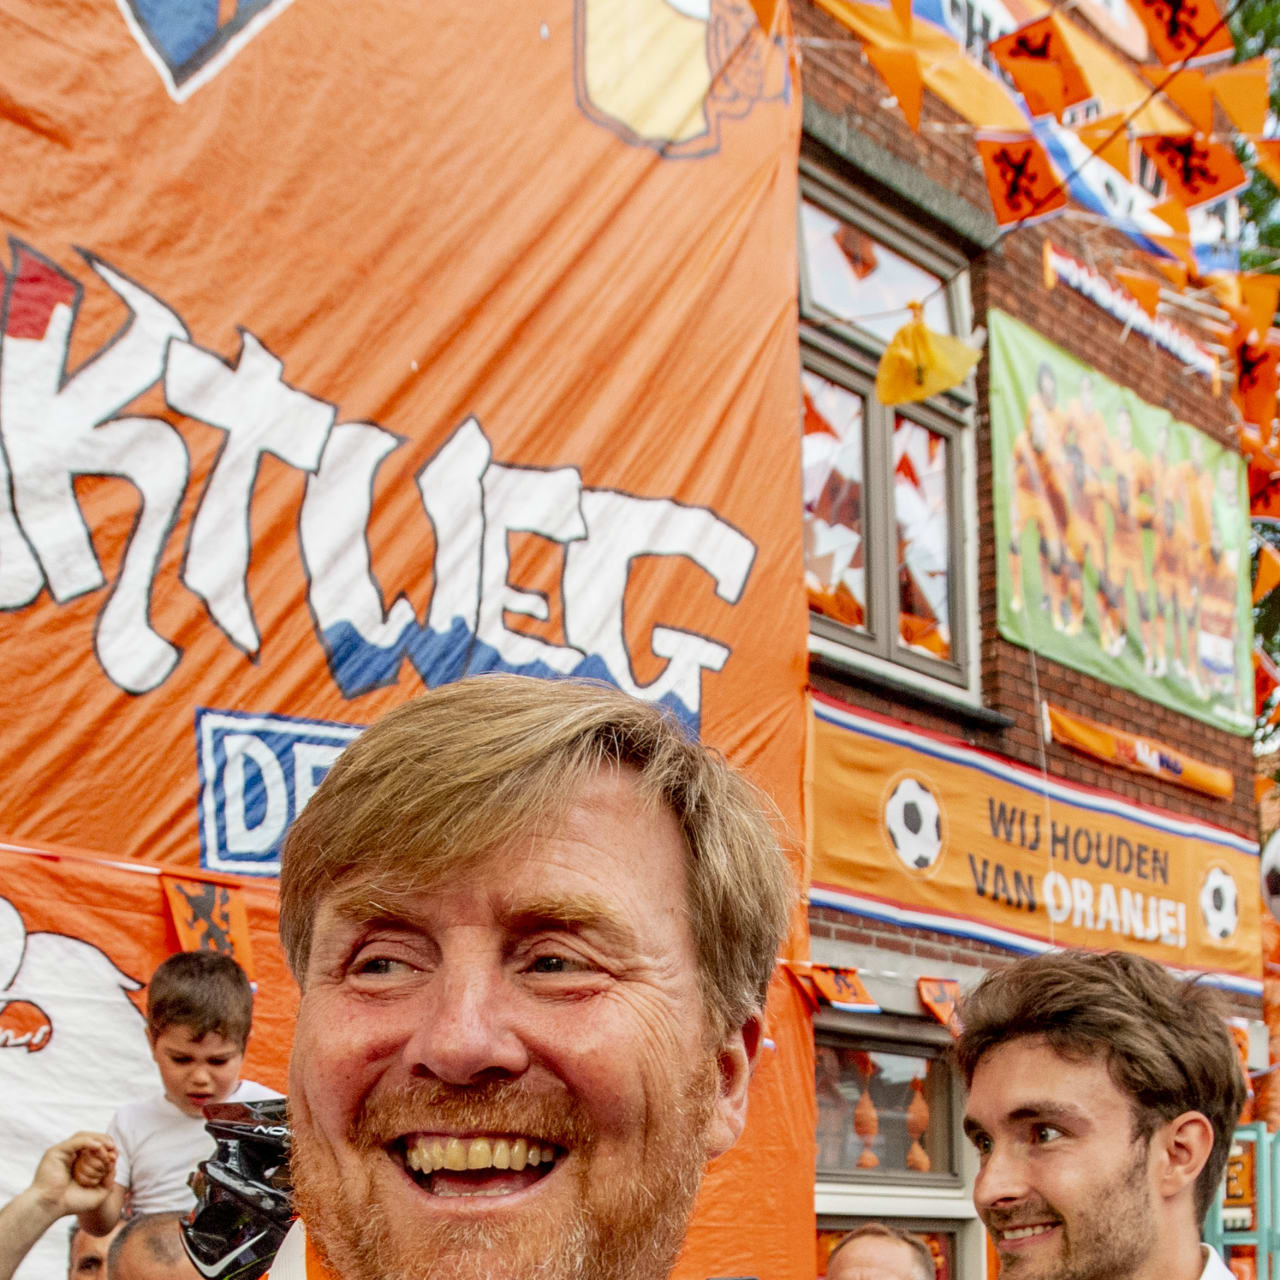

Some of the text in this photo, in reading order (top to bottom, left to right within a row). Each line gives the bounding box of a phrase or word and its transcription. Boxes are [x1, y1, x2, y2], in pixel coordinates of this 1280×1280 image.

[988, 796, 1170, 885] WIJ HOUDEN
[968, 852, 1187, 949] VAN ORANJE!
